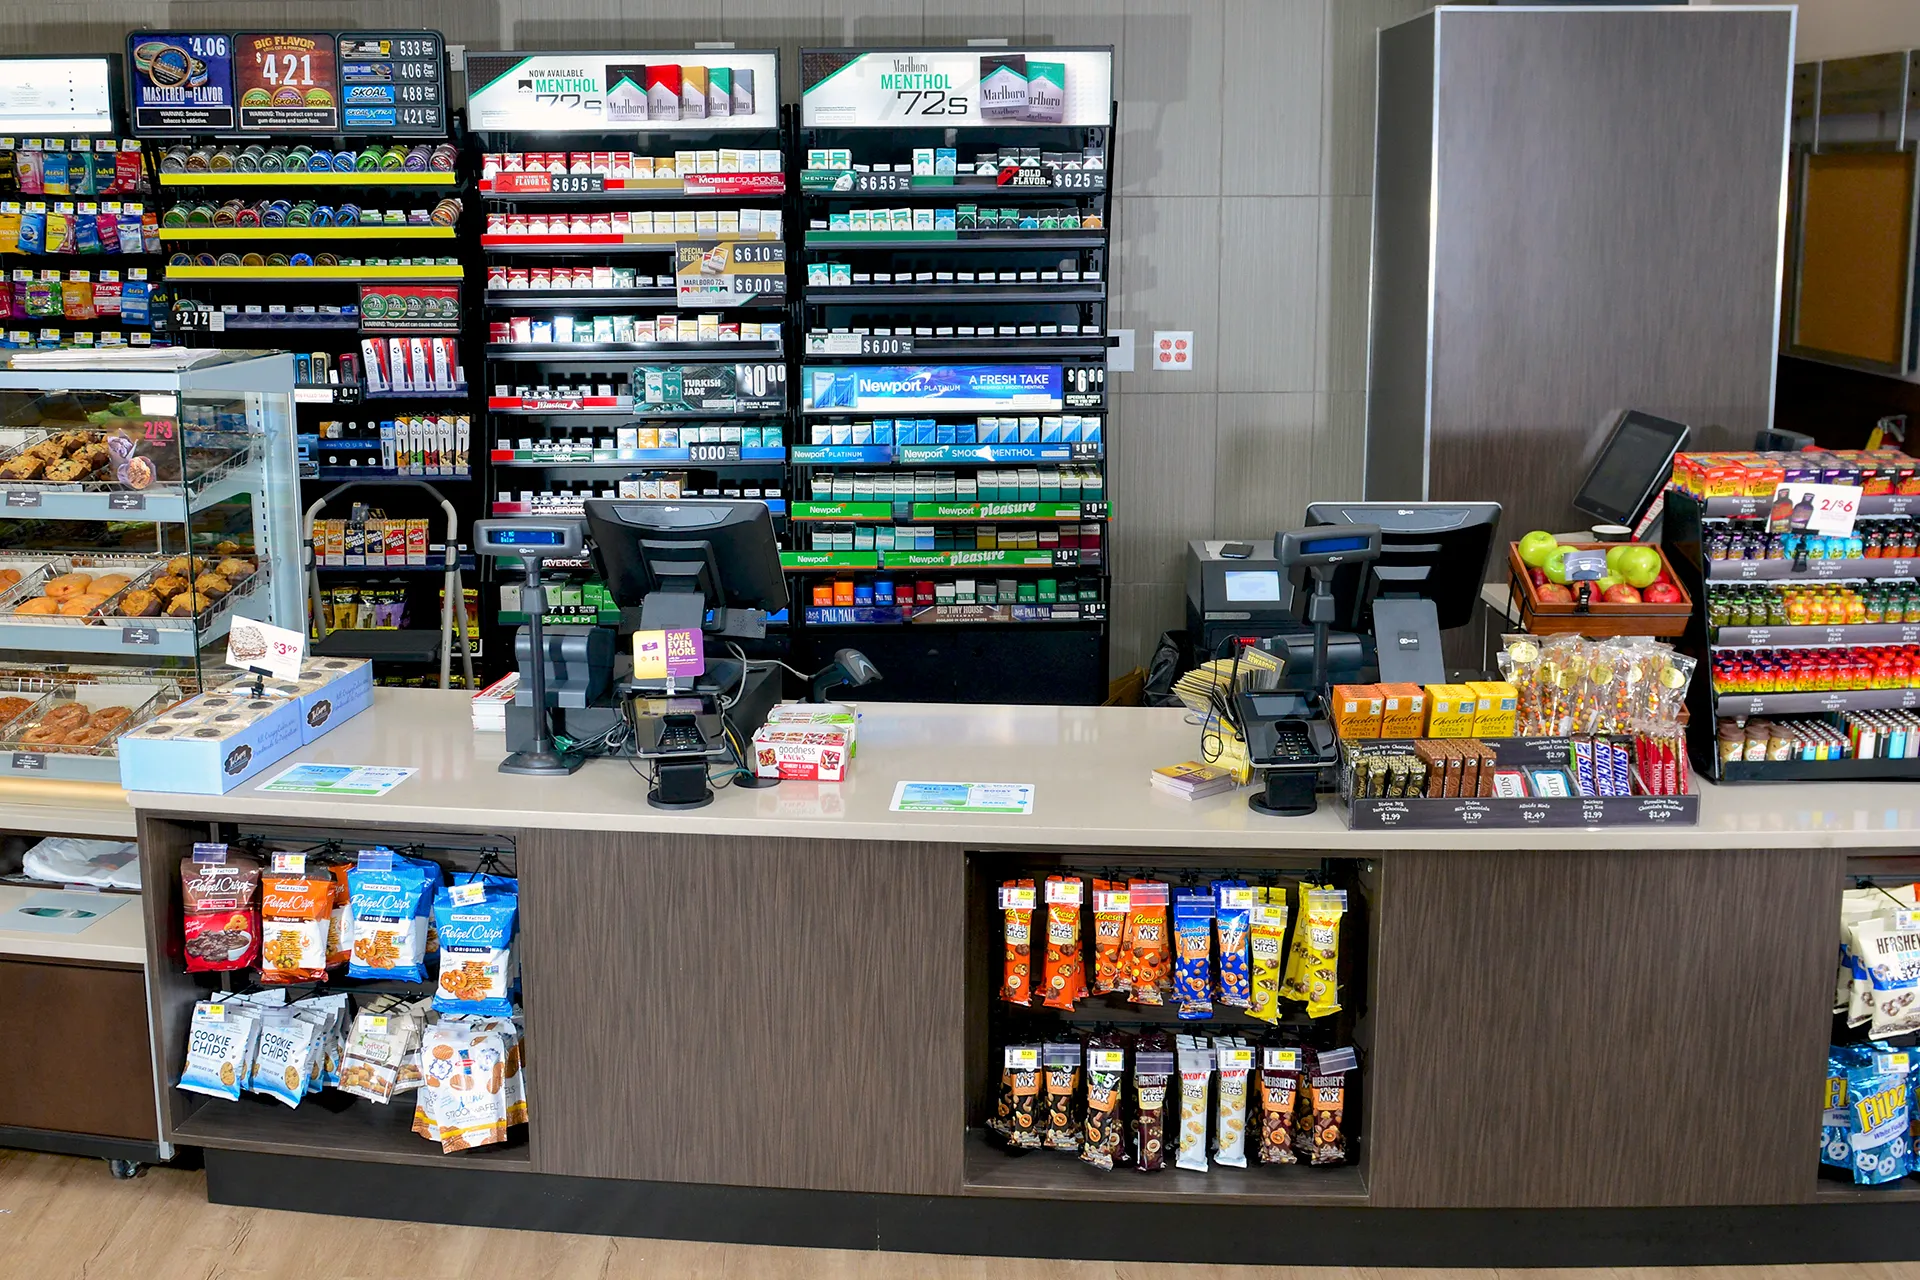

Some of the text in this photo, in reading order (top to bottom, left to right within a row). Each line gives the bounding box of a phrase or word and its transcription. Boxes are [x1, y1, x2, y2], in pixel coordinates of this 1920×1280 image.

[189, 38, 225, 56] $4.06
[253, 38, 273, 50] BIG
[275, 36, 315, 49] FLAVOR
[256, 52, 314, 86] $4.21
[893, 56, 928, 73] Marlboro
[529, 69, 584, 78] NOW AVAILABLE
[536, 78, 598, 92] MENTHOL
[880, 74, 952, 90] MENTHOL
[143, 86, 185, 101] MASTERED
[194, 87, 223, 101] FLAVOR
[351, 87, 387, 97] SKOAL
[984, 85, 1026, 101] Marlboro
[274, 98, 301, 106] SKOAL
[609, 96, 644, 115] Marlboro
[897, 90, 968, 115] 72s
[515, 178, 539, 186] FLAVOR
[553, 178, 588, 191] $6.95
[861, 176, 896, 190] $6.55
[1013, 177, 1046, 185] FLAVOR
[1056, 173, 1090, 187] $6.25
[680, 247, 703, 255] SPECIAL
[735, 247, 770, 261] $6.10
[736, 279, 771, 292] $6.00
[863, 340, 898, 354] $6.00
[684, 379, 720, 387] TURKISH
[969, 375, 1049, 384] A FRESH TAKE
[860, 378, 921, 395] Newport
[144, 421, 172, 439] 2/$3
[397, 427, 407, 436] blu
[411, 427, 421, 436] blu
[424, 427, 434, 436] blu
[439, 427, 449, 435] blu
[691, 446, 725, 460] $0.00
[794, 450, 827, 460] Newport
[904, 450, 943, 459] Newport
[809, 505, 841, 515] Newport
[939, 502, 1036, 518] Newport pleasure
[1820, 499, 1853, 512] 2/$6
[345, 533, 364, 542] Black
[385, 534, 400, 543] Black
[351, 539, 365, 547] Mild
[390, 539, 405, 548] Mild
[798, 555, 829, 564] Newport
[909, 551, 1005, 565] Newport pleasure
[936, 606, 983, 614] BIG TINY HOUSE
[1024, 608, 1036, 617] PALL
[668, 632, 690, 640] SAVE
[668, 640, 692, 648] EVEN
[668, 647, 696, 656] MORE
[1247, 656, 1276, 672] REWARDED
[1342, 715, 1380, 725] Chocolove
[1383, 713, 1423, 723] Chocolove
[1433, 715, 1472, 726] Chocolove
[1475, 713, 1514, 723] Chocolove
[779, 745, 815, 755] goodness
[1381, 813, 1400, 821] $1.99
[1462, 812, 1482, 821] $1.99
[1523, 812, 1545, 820] $2.49
[1583, 811, 1603, 820] $1.99
[1649, 811, 1671, 819] $1.49
[263, 895, 314, 913] Pretzel Crisps
[351, 894, 410, 913] Pretzel Crisps
[1096, 912, 1124, 921] Reese's
[1134, 914, 1163, 924] Reese's
[440, 924, 503, 944] Pretzel Crisps
[1253, 944, 1277, 953] bites
[194, 1030, 231, 1046] COOKIE
[265, 1032, 293, 1049] COOKIE
[192, 1040, 227, 1058] CHIPS
[261, 1043, 288, 1062] CHIPS
[1138, 1075, 1168, 1085] HERSHEY'S
[1141, 1093, 1164, 1102] bites
[1856, 1083, 1906, 1134] Flipz
[1874, 1128, 1890, 1139] White
